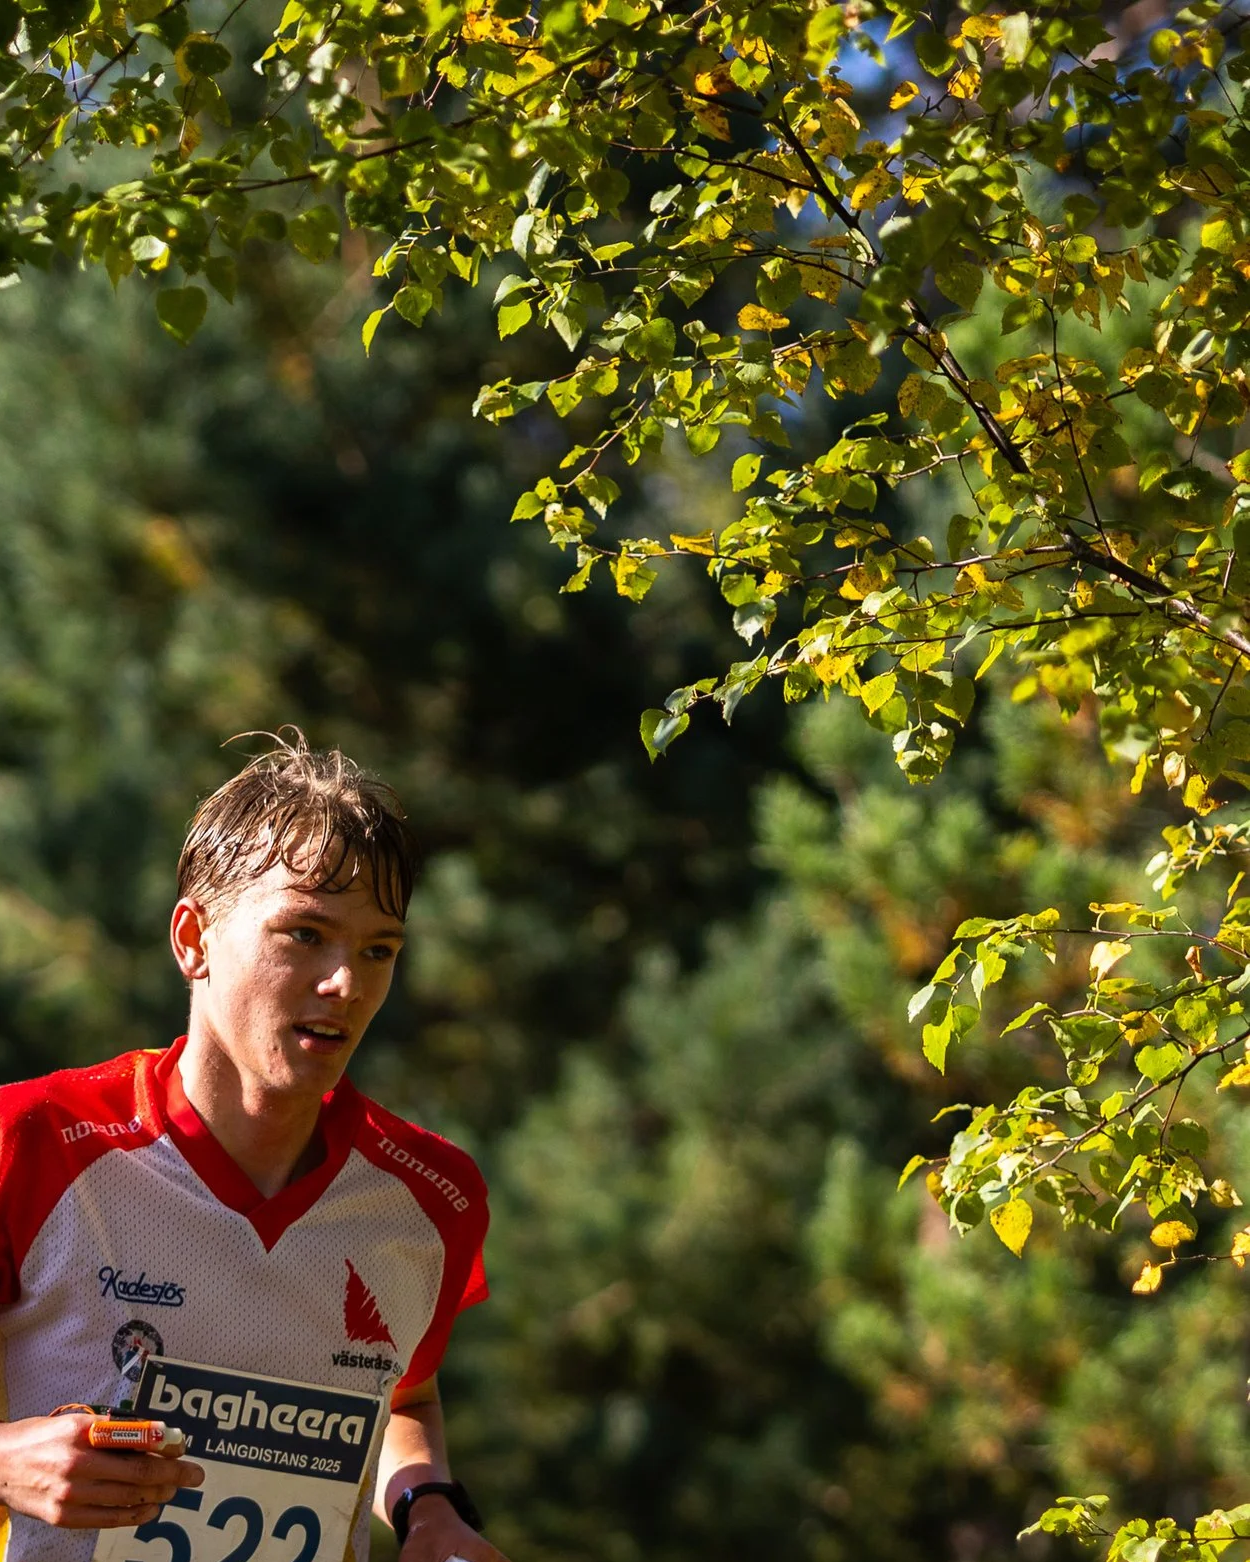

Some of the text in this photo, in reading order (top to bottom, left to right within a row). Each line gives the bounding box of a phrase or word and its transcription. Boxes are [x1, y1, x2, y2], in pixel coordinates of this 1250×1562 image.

[377, 1136, 469, 1213] noname
[98, 1266, 186, 1307] Kadesjös
[331, 1350, 393, 1371] västerås
[149, 1374, 366, 1445] bagheera
[310, 1456, 342, 1474] 2025
